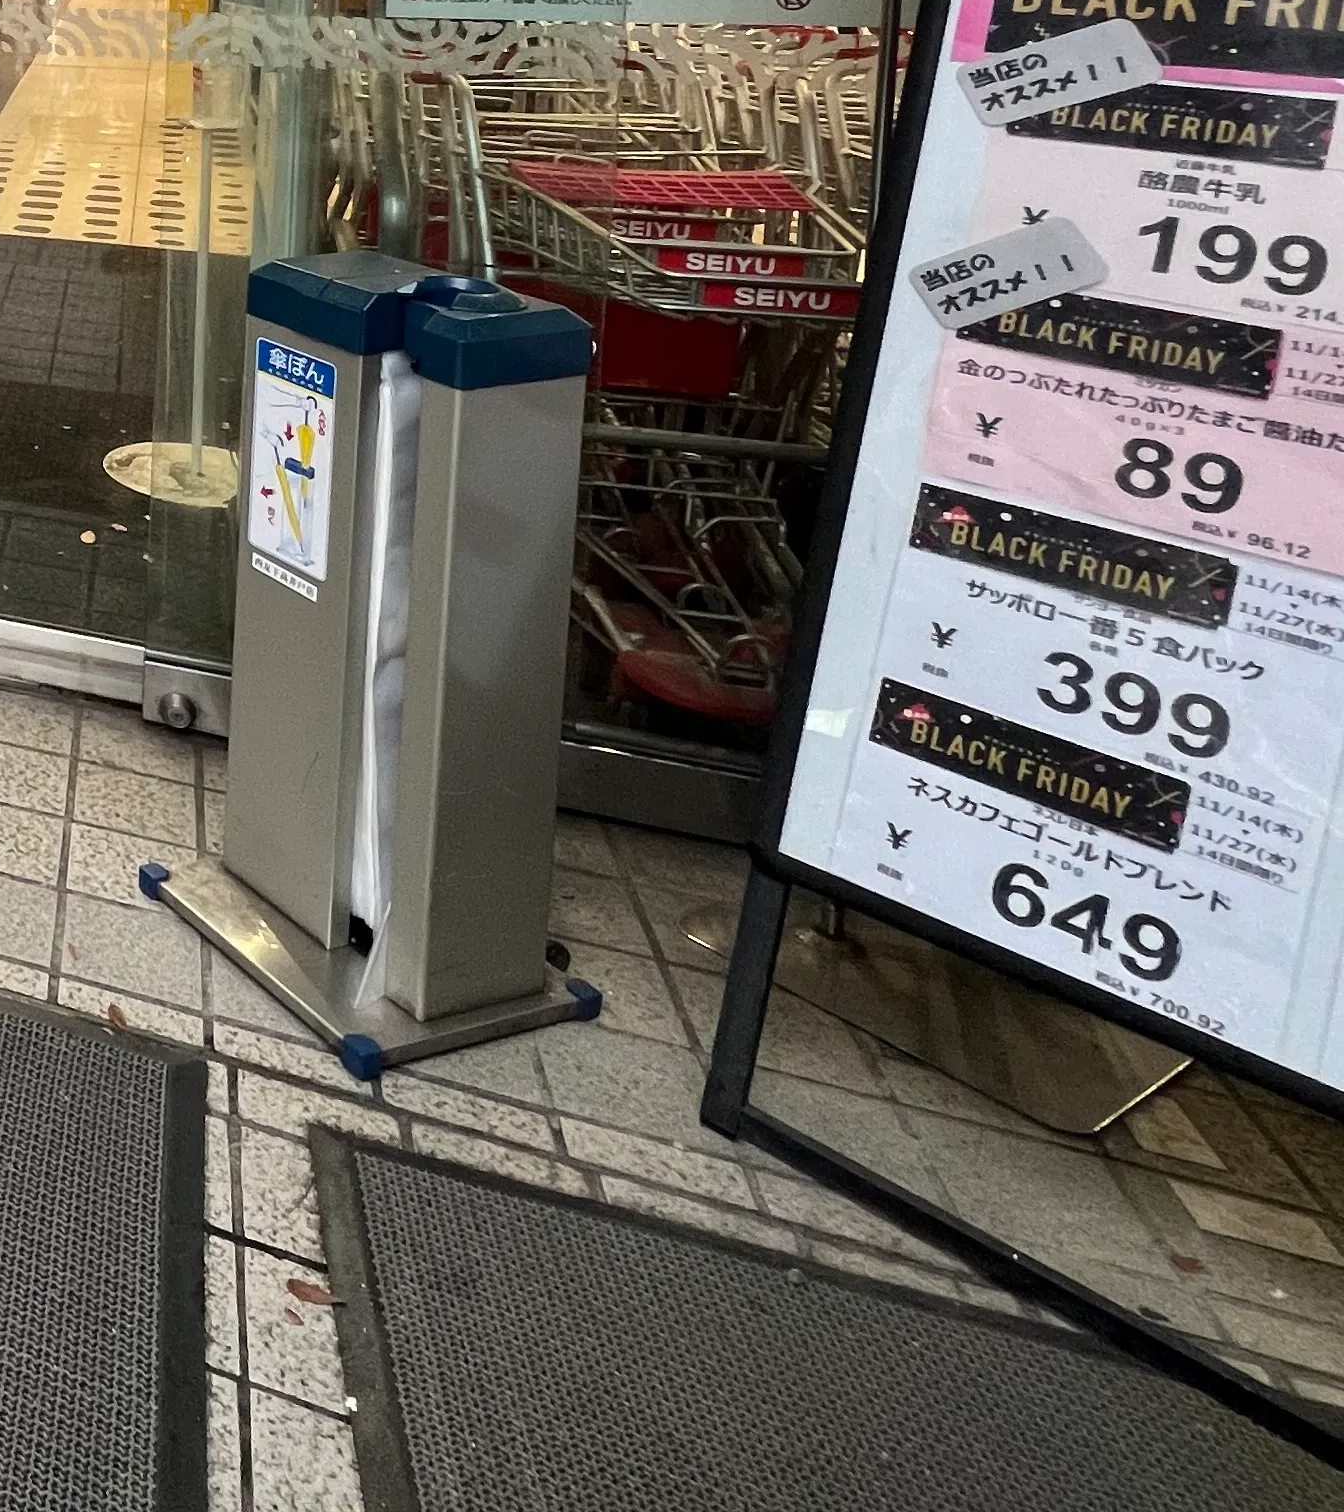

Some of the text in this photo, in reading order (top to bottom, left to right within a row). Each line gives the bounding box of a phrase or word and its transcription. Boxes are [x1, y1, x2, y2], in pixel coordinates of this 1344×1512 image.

[967, 53, 1047, 89] 当店の
[1050, 104, 1148, 135] BLACK
[1160, 114, 1280, 149] FRIDAY
[1138, 170, 1266, 204] 酪農牛乳
[611, 218, 690, 239] SEIYU
[685, 252, 776, 275] SEIYU
[920, 253, 995, 291] 当店の
[1138, 216, 1328, 296] 199
[733, 287, 831, 310] SEIYU
[998, 311, 1098, 350] BLACK
[1107, 335, 1225, 375] FRIDAY
[1291, 340, 1344, 358] 11/1
[268, 347, 325, 386] 傘ぽん
[976, 412, 1244, 514] ¥ 89
[950, 518, 1046, 568] BLACK
[1058, 548, 1175, 600] FRIDAY
[1247, 532, 1311, 559] 96.12
[930, 621, 1231, 759] ¥ 399
[910, 720, 1131, 818] BLACK FRIDAY
[1198, 771, 1275, 806] 430.92
[906, 776, 1233, 914] ネスカフェゴールドブレンド
[885, 821, 1182, 982] ¥ 649
[1149, 992, 1227, 1036] 700.92
